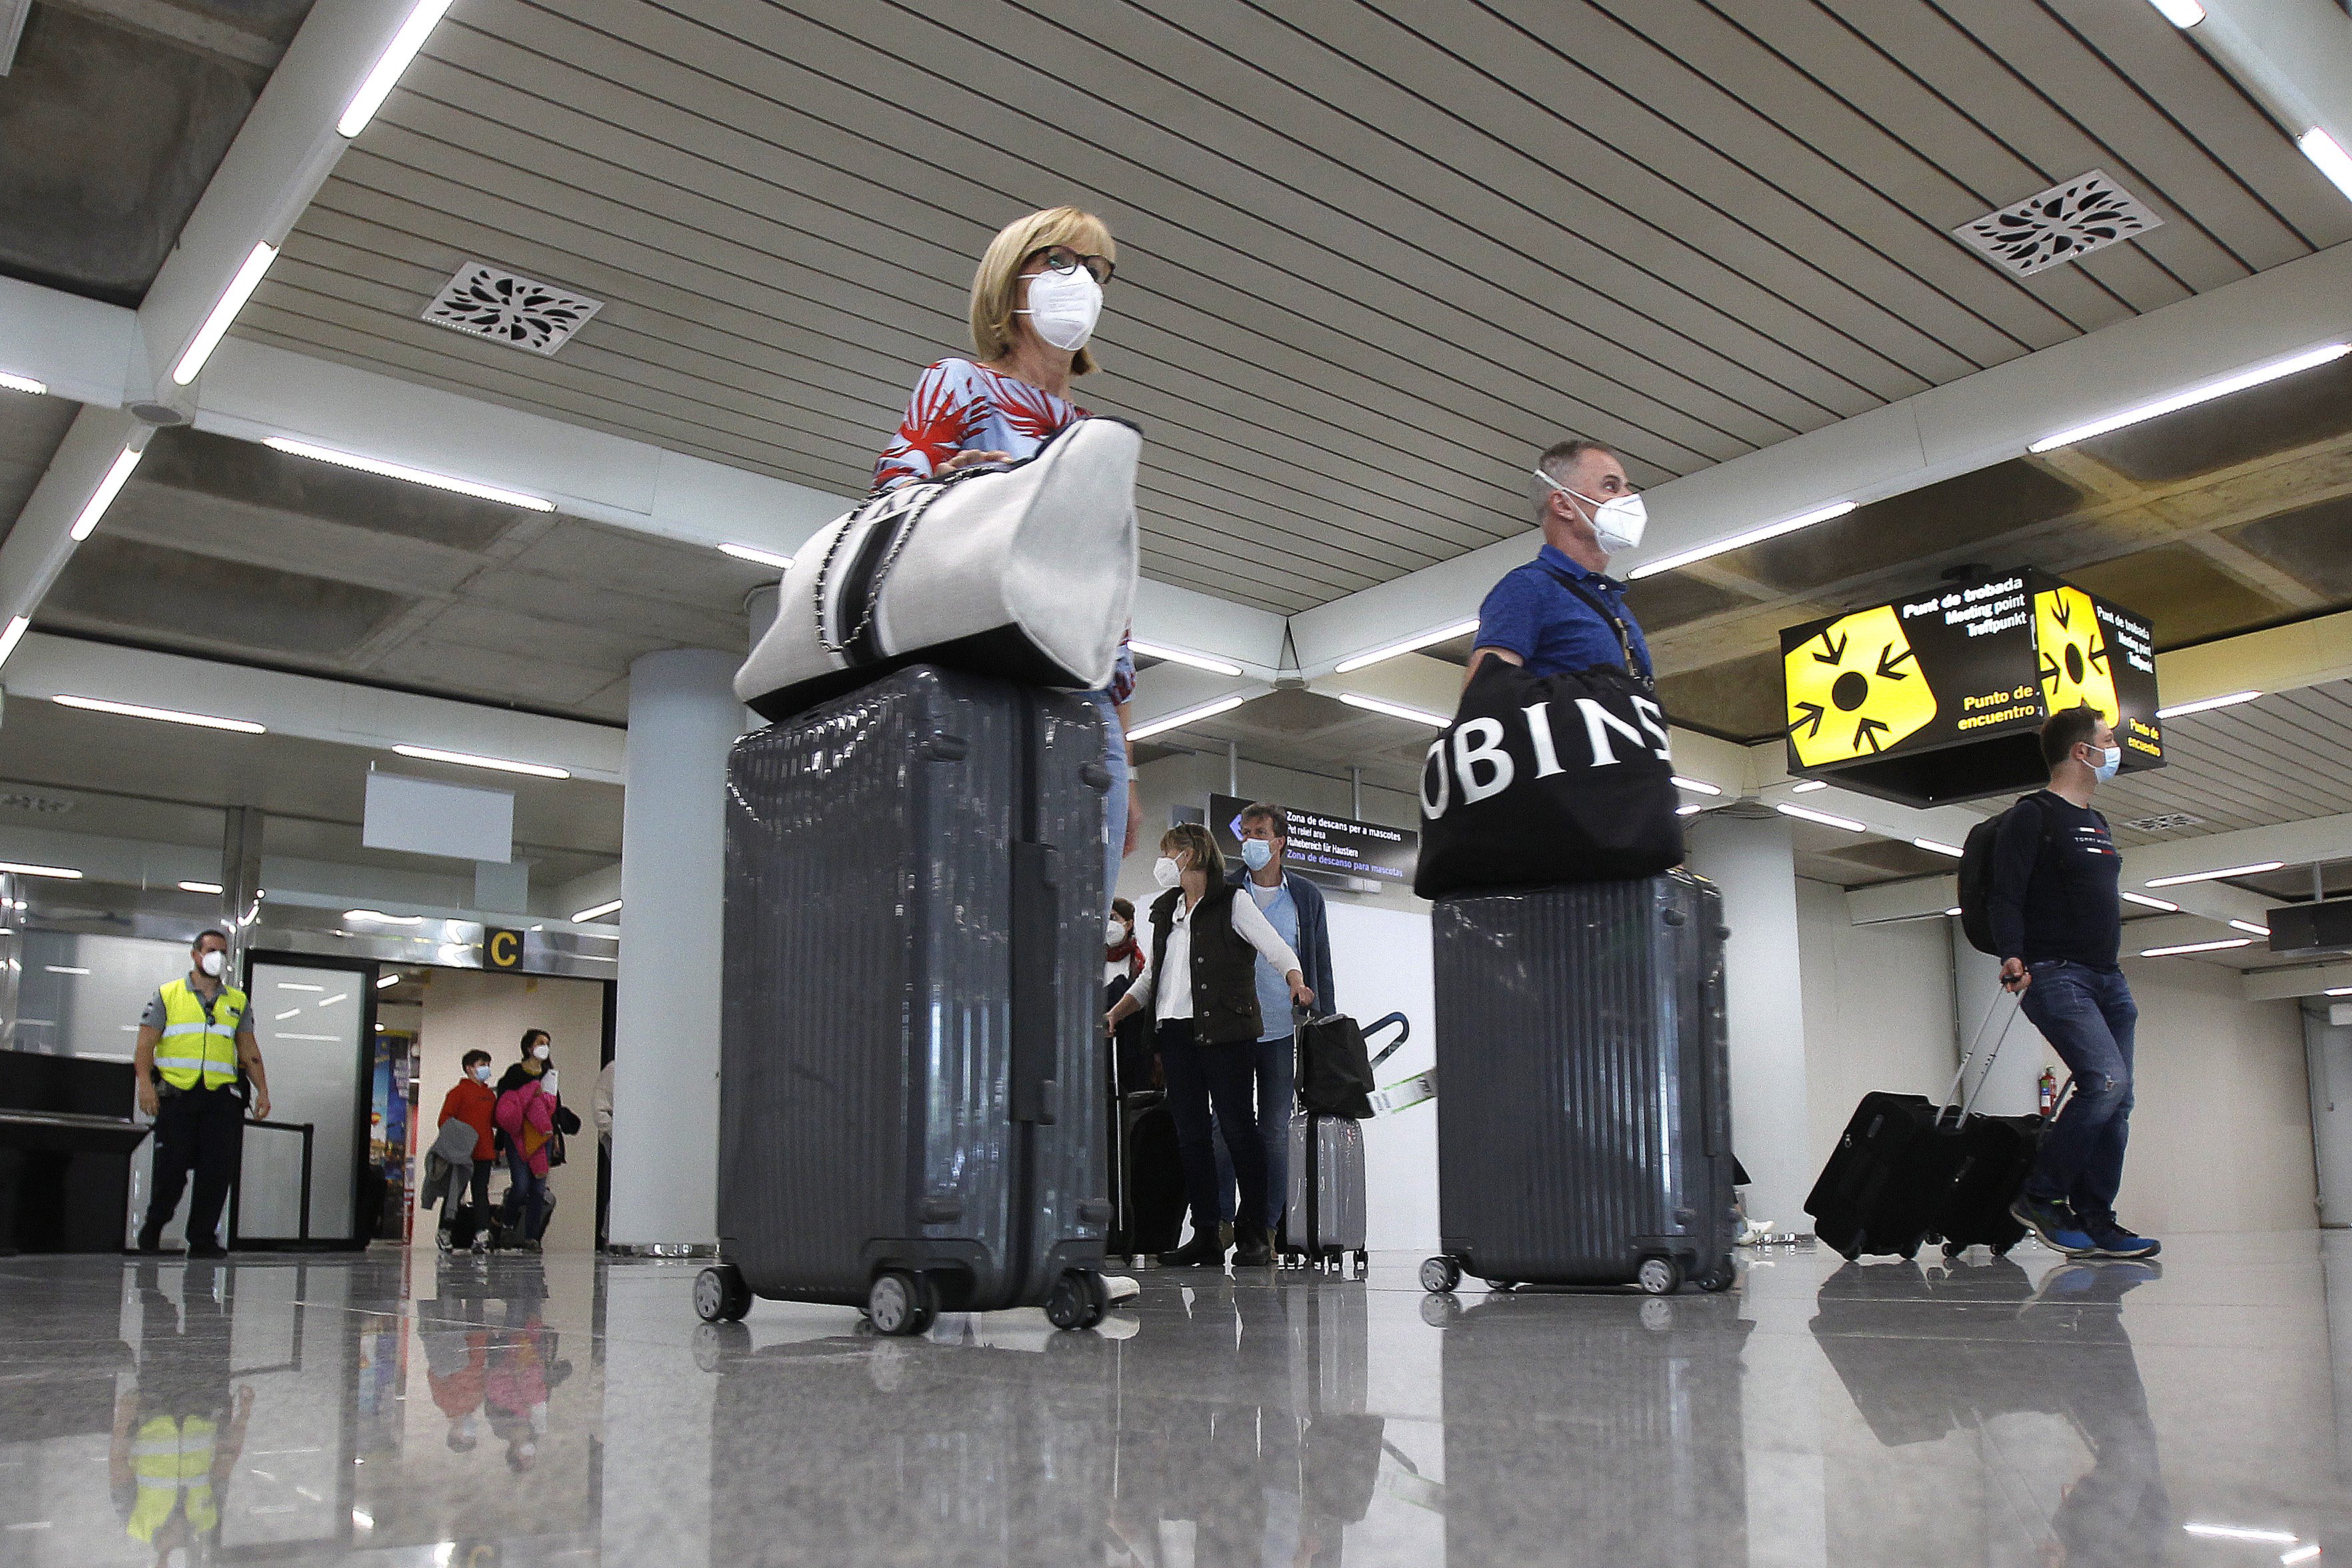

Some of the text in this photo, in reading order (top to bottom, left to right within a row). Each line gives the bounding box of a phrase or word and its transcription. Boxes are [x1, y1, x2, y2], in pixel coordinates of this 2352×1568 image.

[1903, 577, 2023, 619] Punt de trobada
[1945, 593, 2025, 625] Meeting point
[1967, 611, 2027, 637] Treffpunkt
[2115, 614, 2125, 628] de
[1963, 685, 2033, 711] Punto de
[1957, 705, 2035, 731] encuentro
[2129, 717, 2159, 741] Punto de
[2127, 737, 2161, 757] encuentro
[1287, 811, 1305, 824] Zona
[1307, 815, 1317, 826] de
[1318, 817, 1348, 831] descans
[1349, 825, 1361, 834] per
[1369, 828, 1401, 842] mascotes
[1287, 823, 1326, 840] Pet relief area
[1287, 836, 1359, 858] Ruhebereich für Haustiere
[1287, 849, 1403, 877] Zona de descanso para mascotas
[491, 931, 518, 967] C
